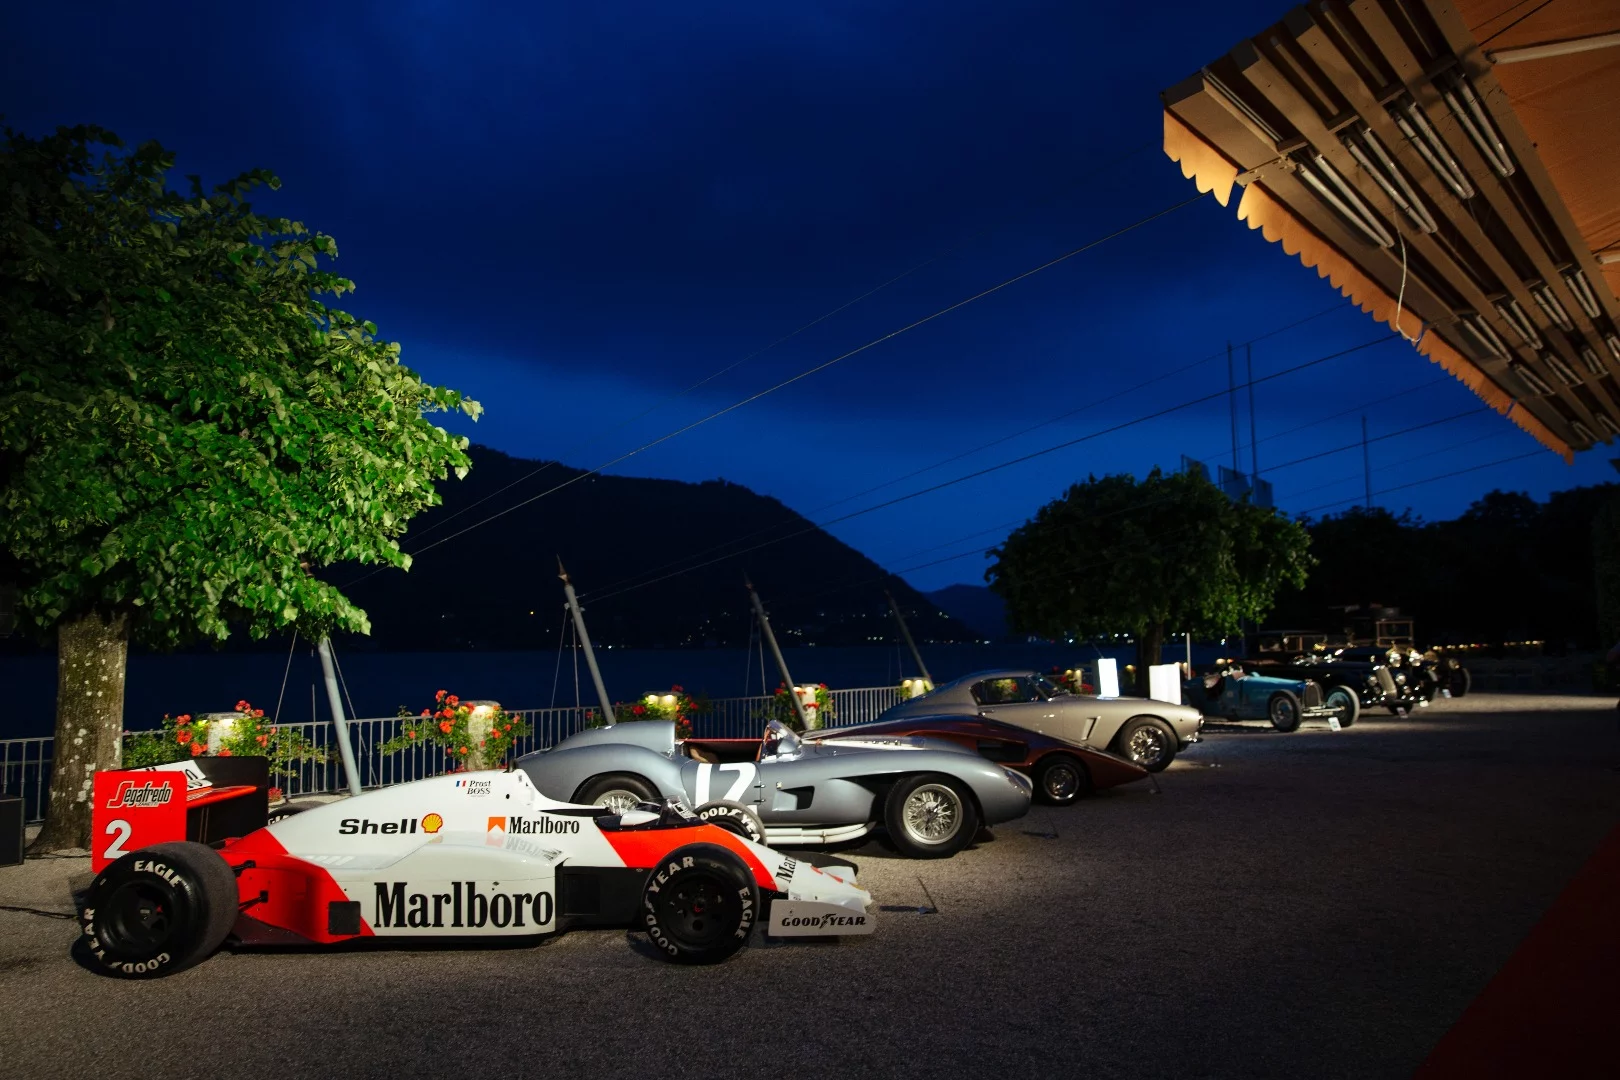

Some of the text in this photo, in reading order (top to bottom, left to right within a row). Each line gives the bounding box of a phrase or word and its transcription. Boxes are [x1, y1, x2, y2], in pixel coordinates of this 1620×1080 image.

[106, 781, 174, 808] Segafredo
[468, 780, 491, 788] Prost
[339, 818, 417, 834] Shell
[508, 816, 580, 834] Marlboro
[700, 806, 761, 843] OODYEA
[103, 819, 132, 859] 2
[133, 860, 184, 888] EAGLE
[374, 881, 554, 928] Marlboro
[733, 887, 753, 940] EAGLE
